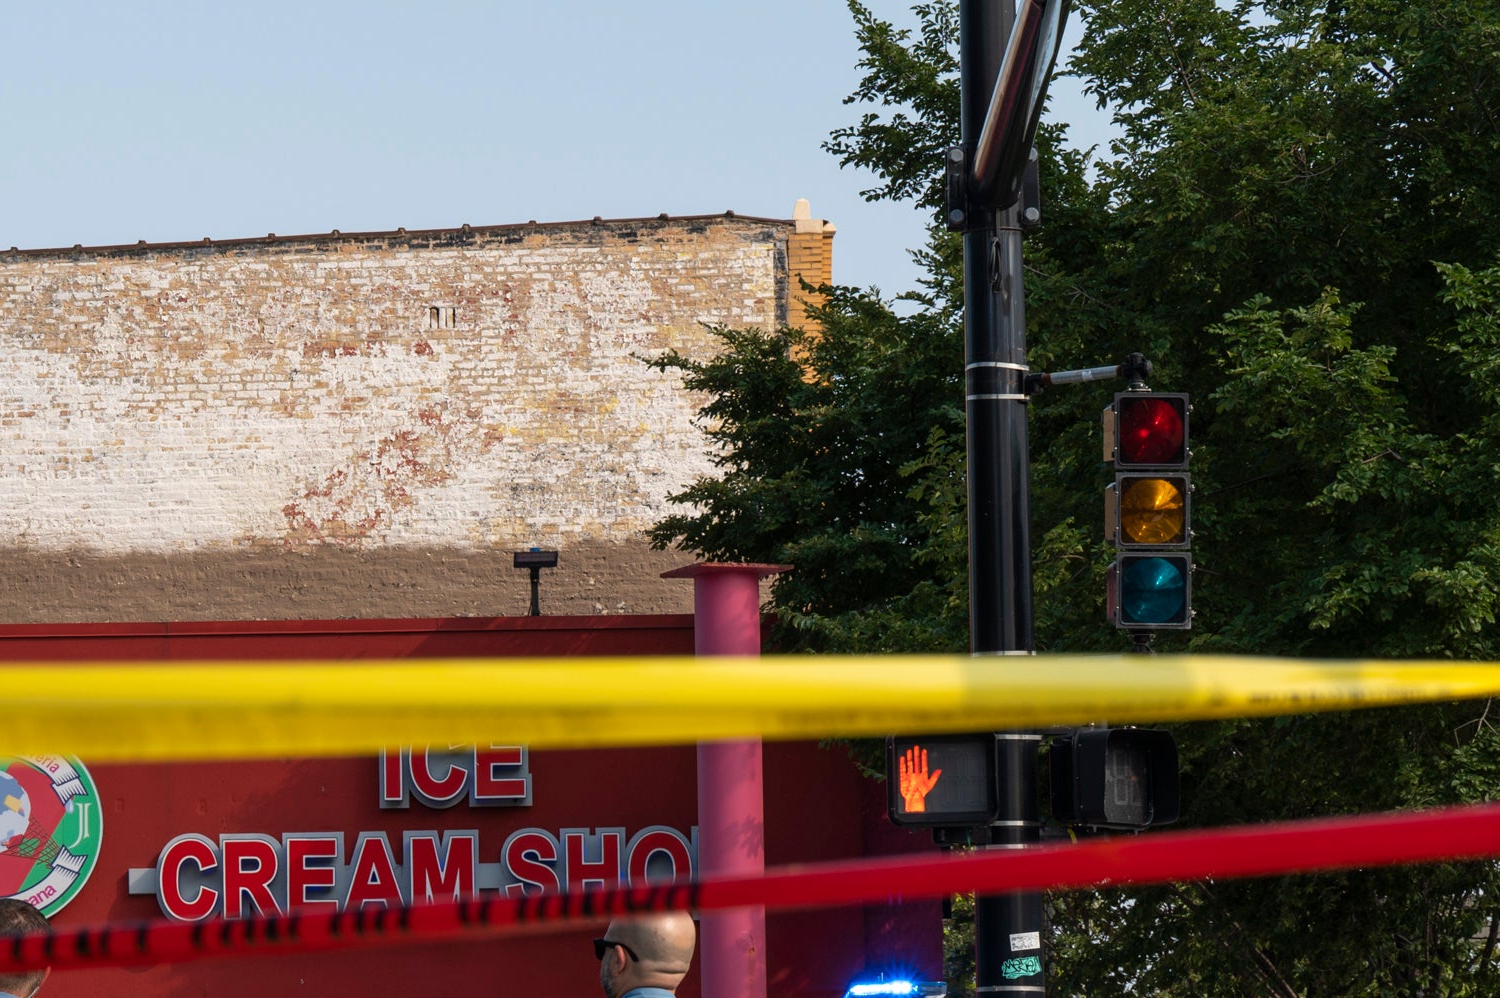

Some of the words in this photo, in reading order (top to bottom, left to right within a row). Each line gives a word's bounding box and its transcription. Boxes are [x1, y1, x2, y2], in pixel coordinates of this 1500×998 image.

[384, 742, 527, 801] ICE
[67, 802, 93, 850] J
[159, 834, 477, 922] CREAM
[504, 831, 694, 902] SHO
